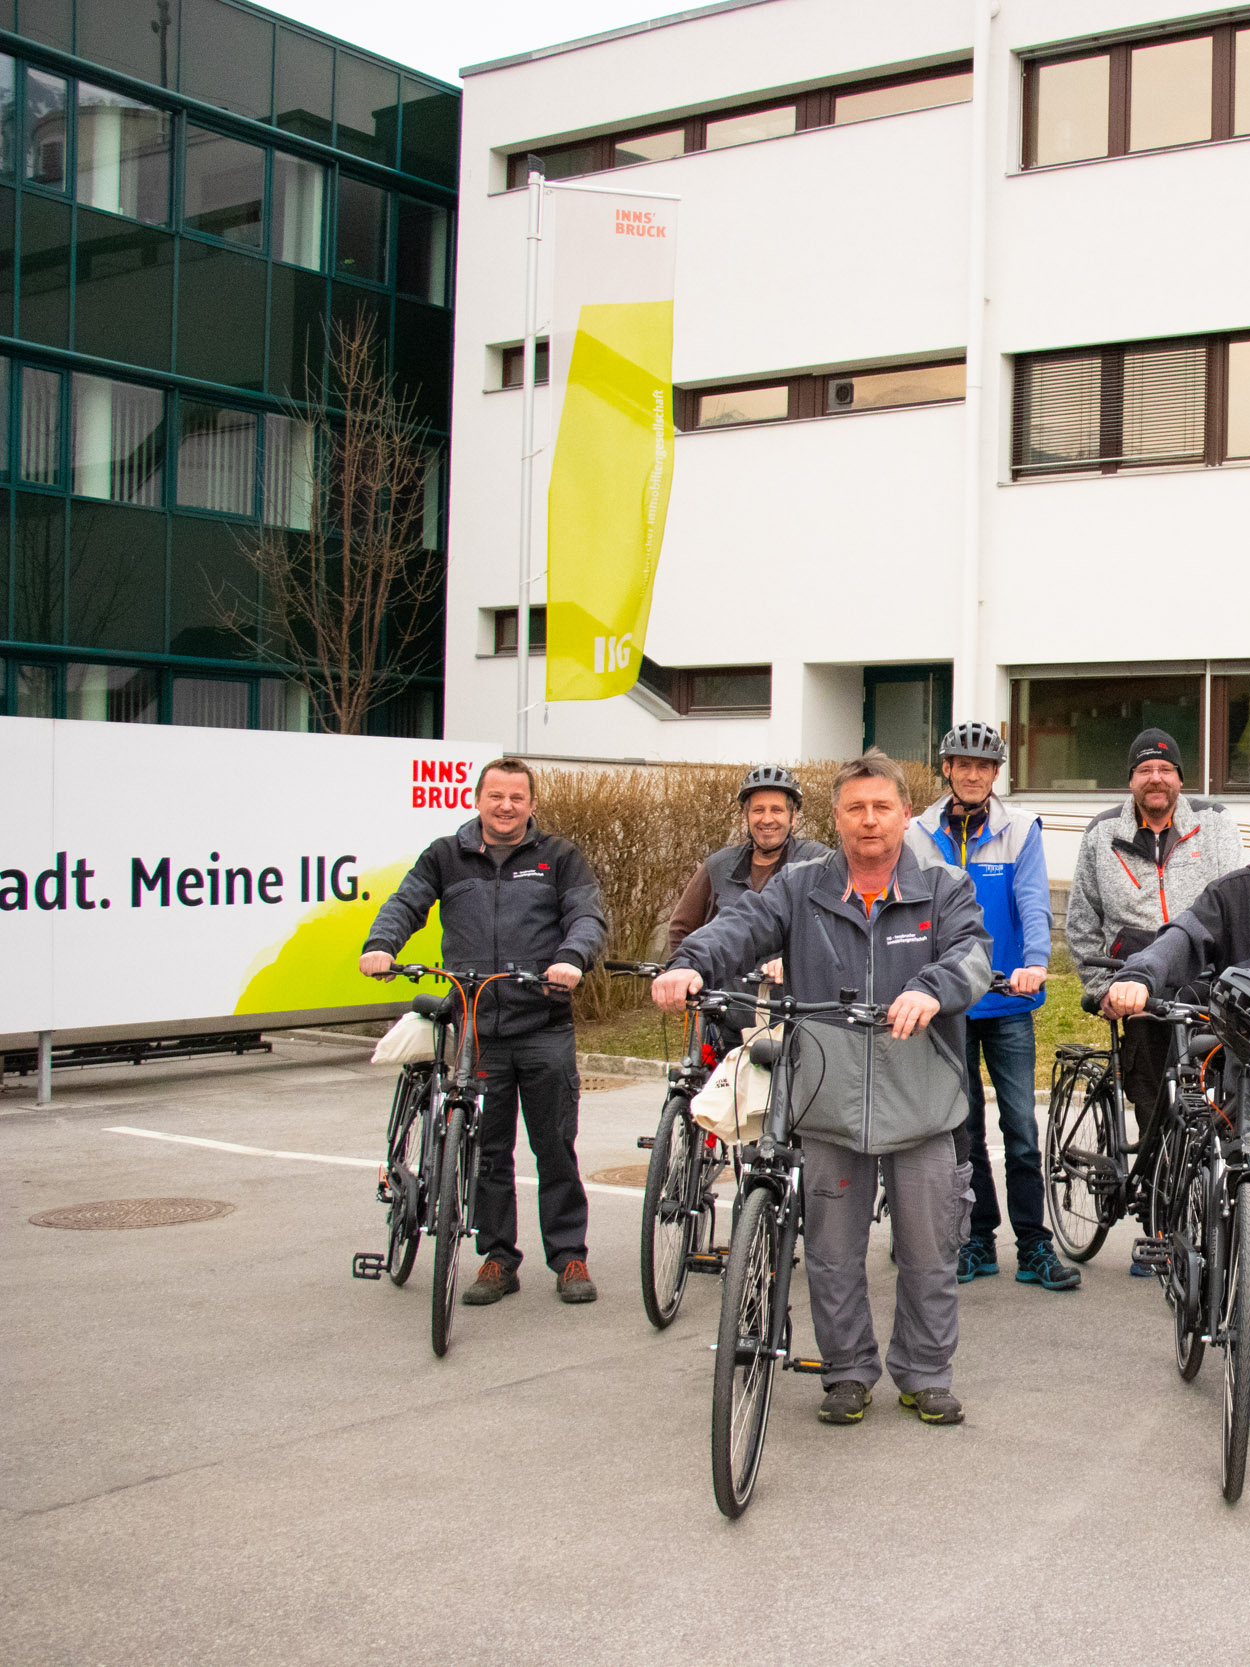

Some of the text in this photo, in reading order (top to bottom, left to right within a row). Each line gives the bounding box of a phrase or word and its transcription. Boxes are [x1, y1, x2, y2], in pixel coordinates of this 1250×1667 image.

[615, 208, 656, 224] INNS'
[615, 222, 667, 238] BRUCK
[594, 632, 633, 674] IIG
[412, 759, 473, 784] INNS'
[412, 785, 477, 810] BRUC
[131, 851, 284, 907] Meine
[300, 854, 371, 902] IIG.
